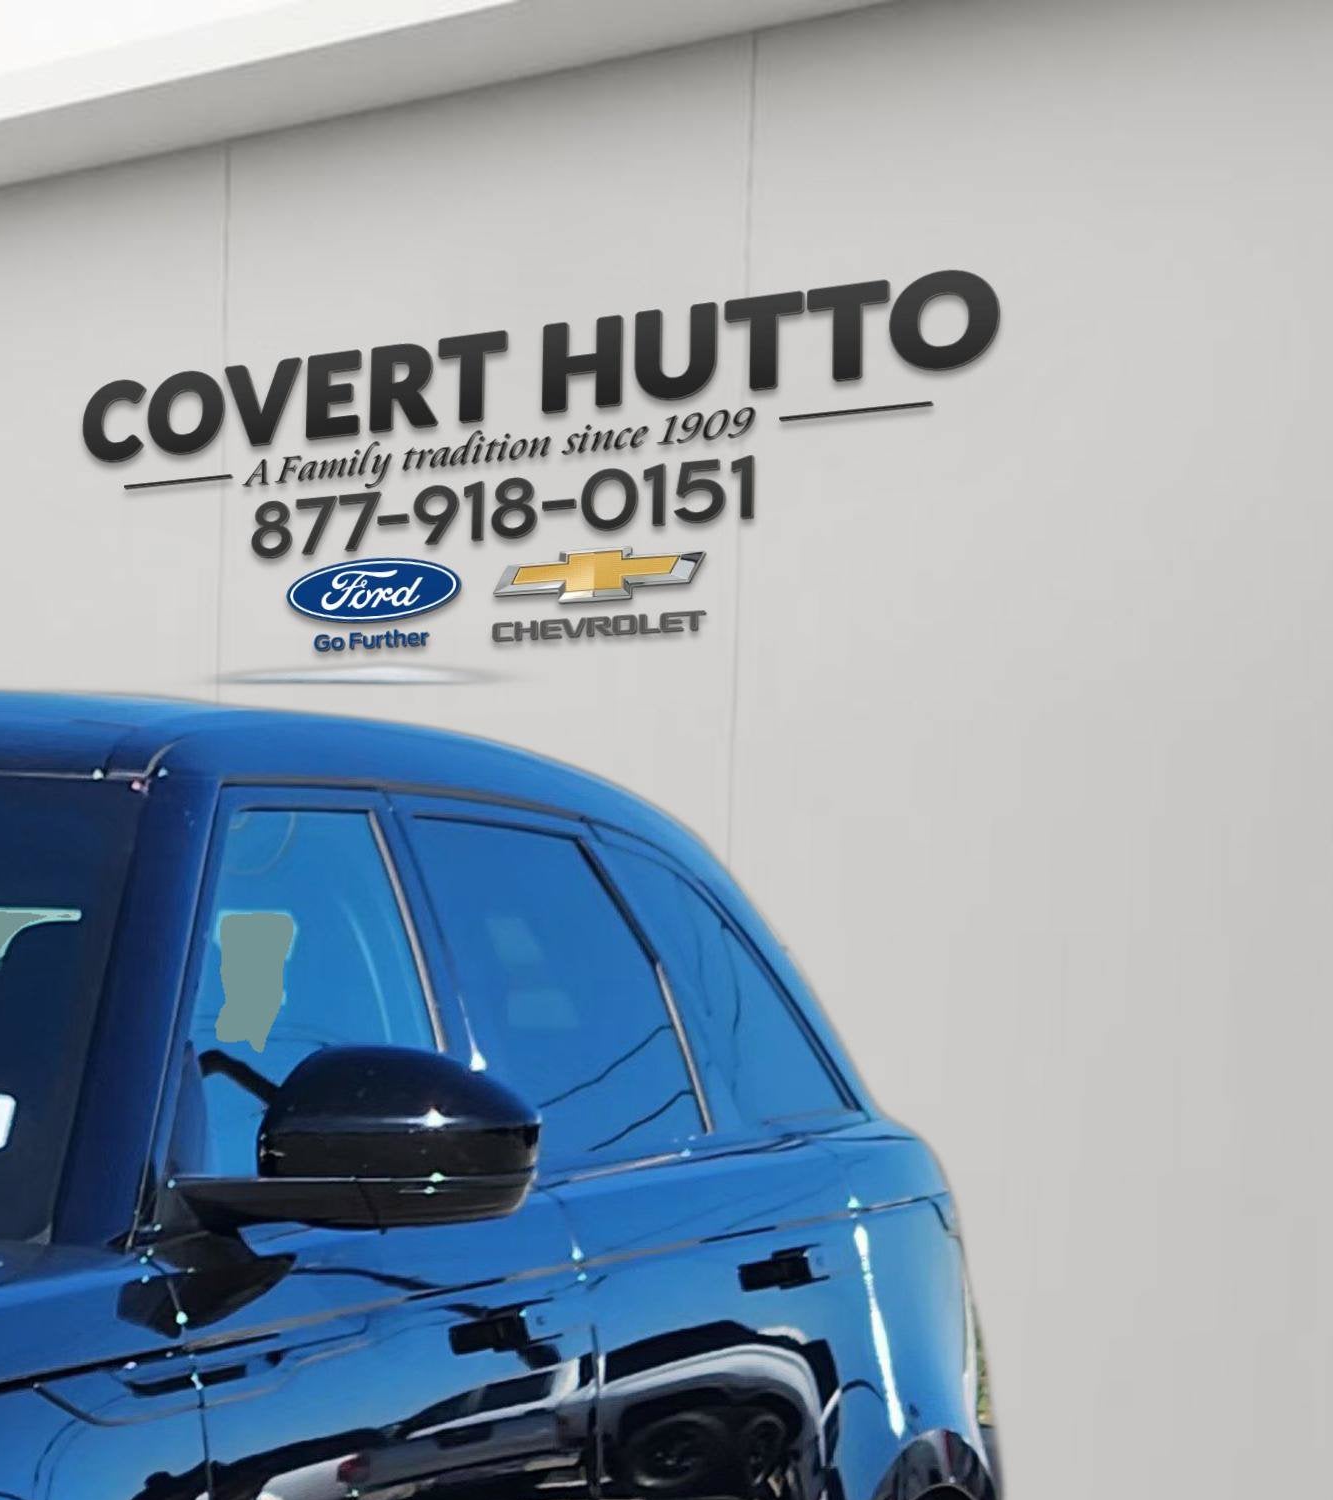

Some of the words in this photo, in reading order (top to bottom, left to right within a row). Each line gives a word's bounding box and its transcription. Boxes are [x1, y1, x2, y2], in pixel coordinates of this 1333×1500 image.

[82, 331, 509, 464] COVERT
[541, 269, 1001, 414] HUTTO
[242, 457, 270, 488] A
[274, 441, 393, 488] Family
[402, 429, 551, 472] tradition
[561, 424, 649, 457] since
[656, 406, 757, 446] 1909
[251, 456, 755, 560] 877-918-0151
[320, 569, 421, 611] Ford
[313, 633, 346, 653] Go
[349, 629, 430, 650] Further
[491, 609, 707, 643] CHEVROLET
